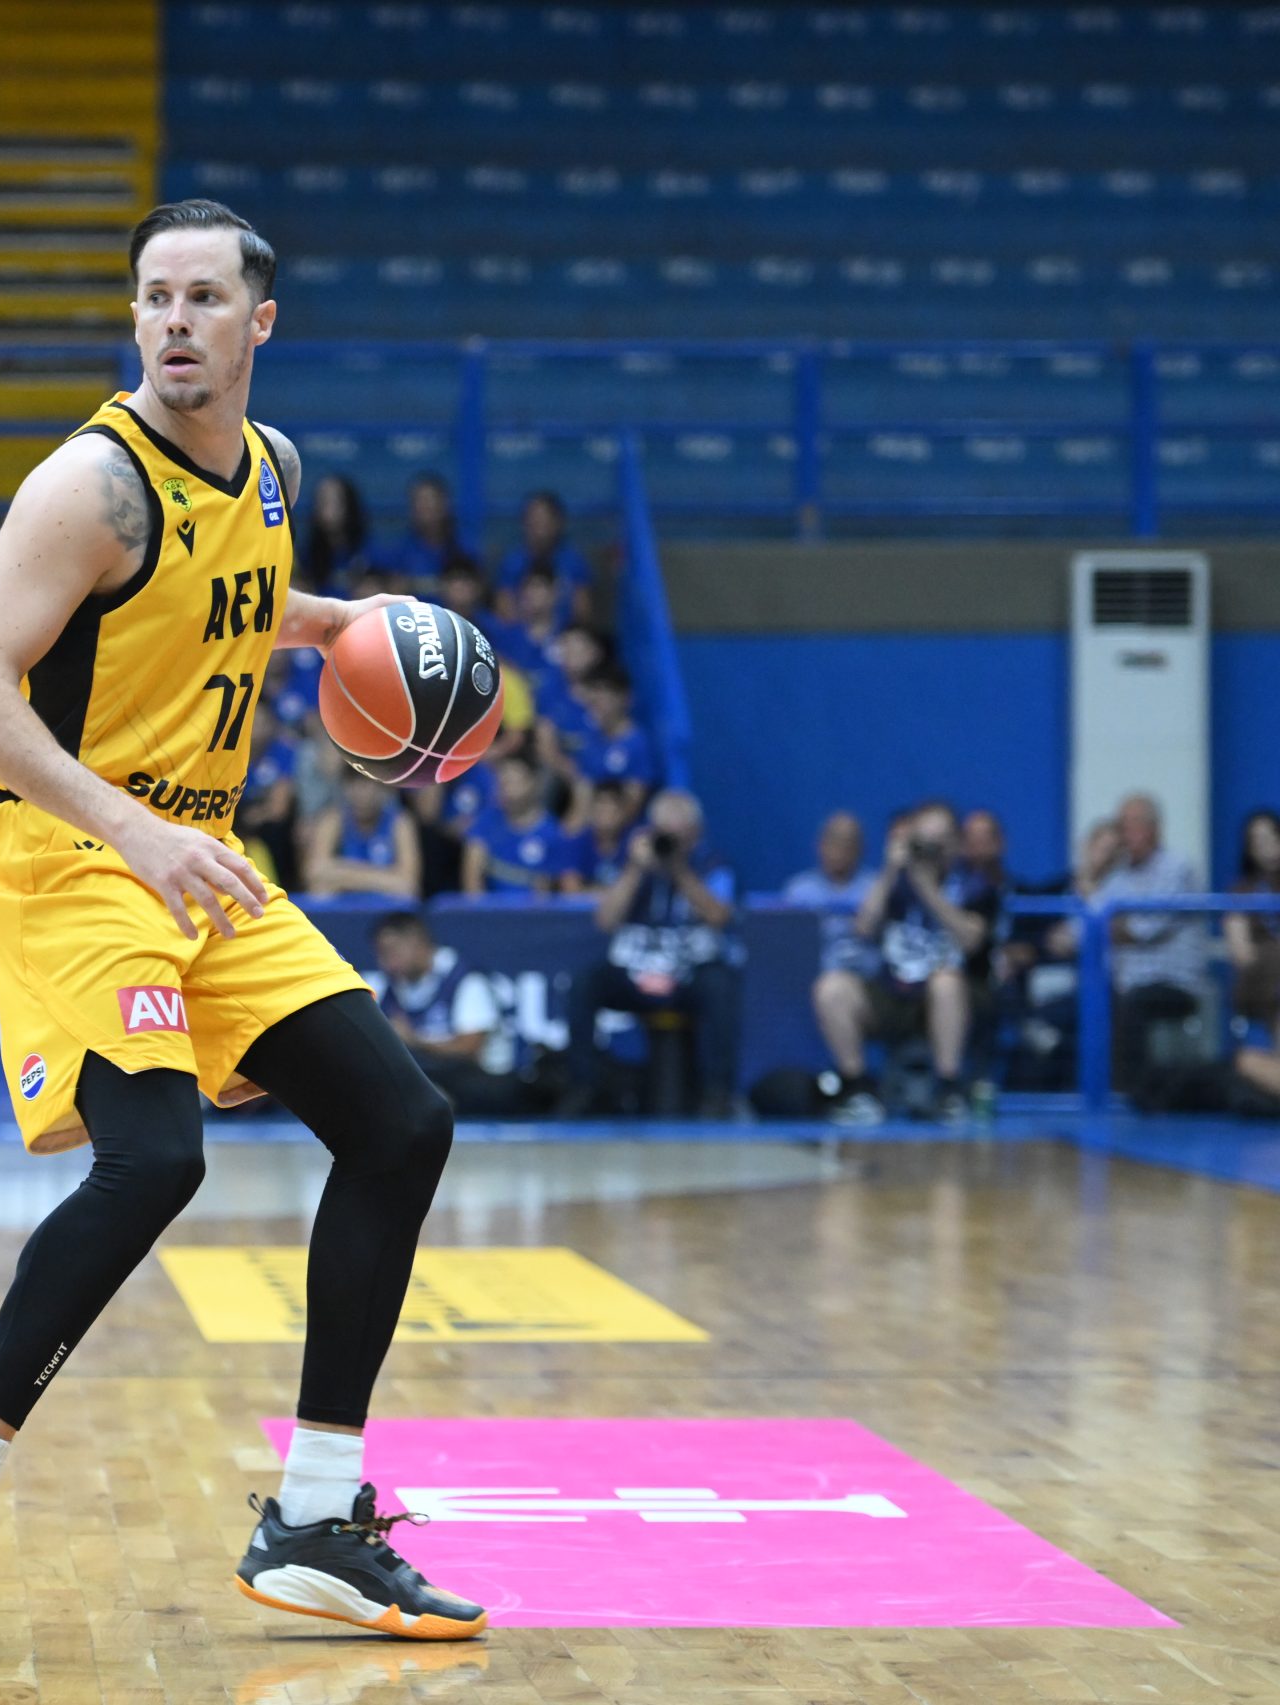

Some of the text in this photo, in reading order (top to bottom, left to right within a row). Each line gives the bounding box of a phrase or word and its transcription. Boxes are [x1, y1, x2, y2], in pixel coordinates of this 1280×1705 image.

[202, 565, 276, 643] AEK
[21, 1065, 44, 1088] PEPSI
[33, 1342, 67, 1386] TECHFIT
